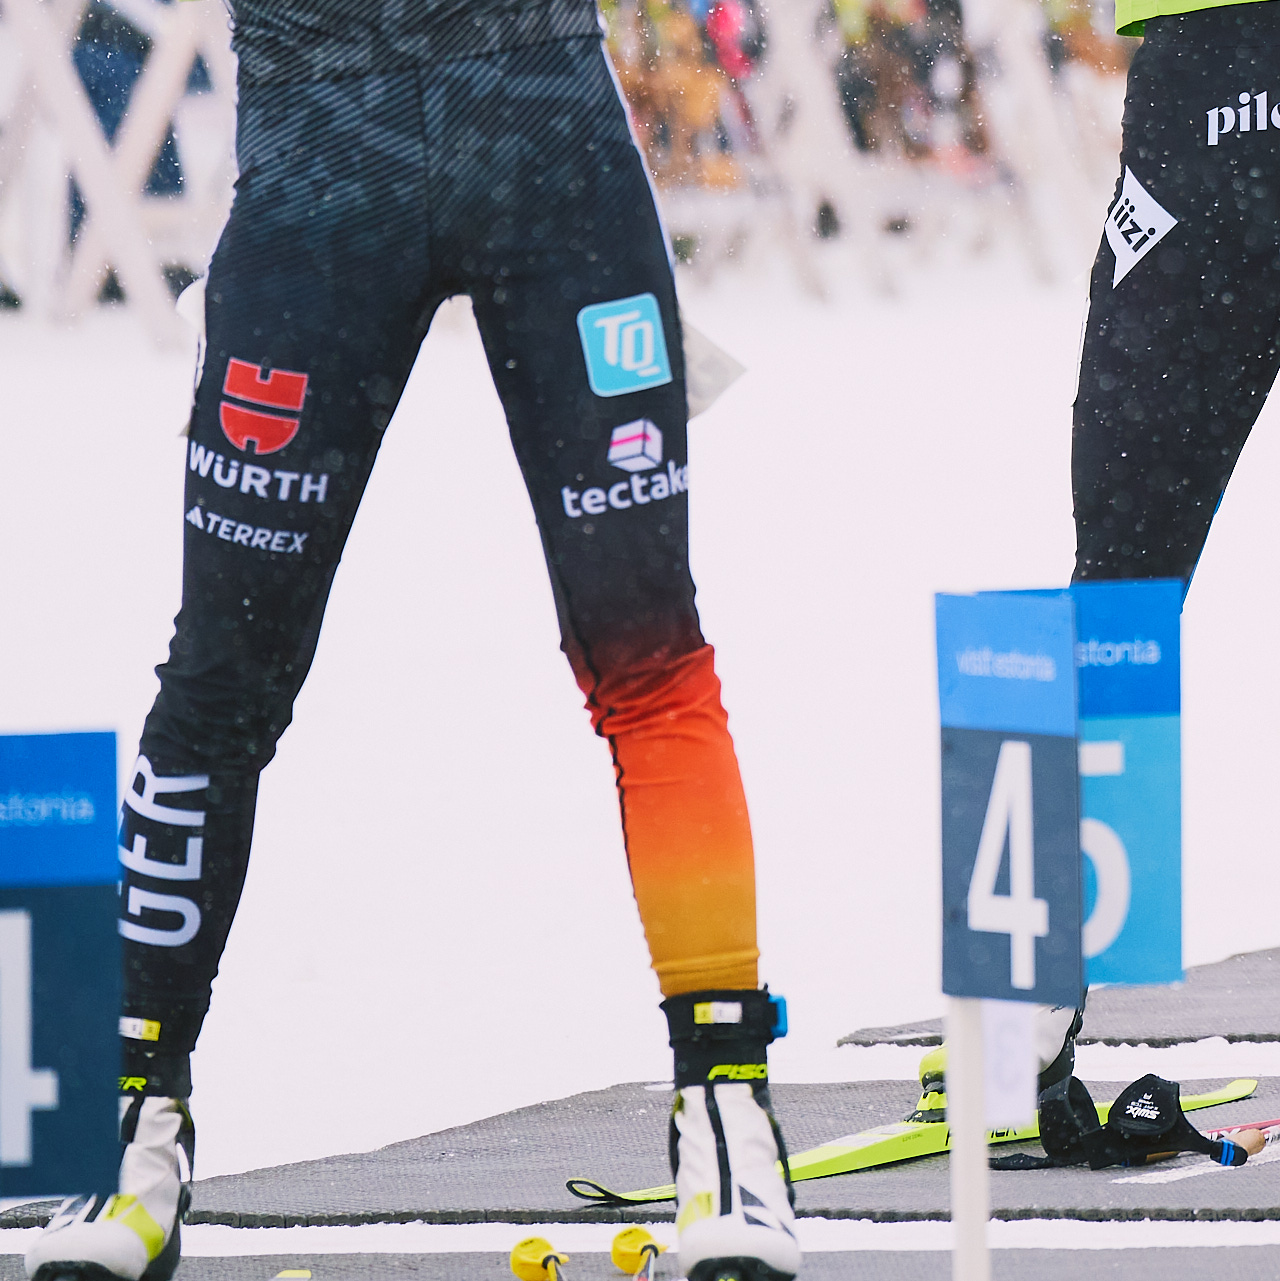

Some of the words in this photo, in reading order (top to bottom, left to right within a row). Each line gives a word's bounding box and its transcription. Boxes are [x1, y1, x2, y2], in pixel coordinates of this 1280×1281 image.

[1115, 197, 1157, 254] iizi
[594, 309, 665, 379] TQ
[205, 510, 310, 555] TERREX
[119, 753, 210, 948] GER
[967, 740, 1049, 991] 4
